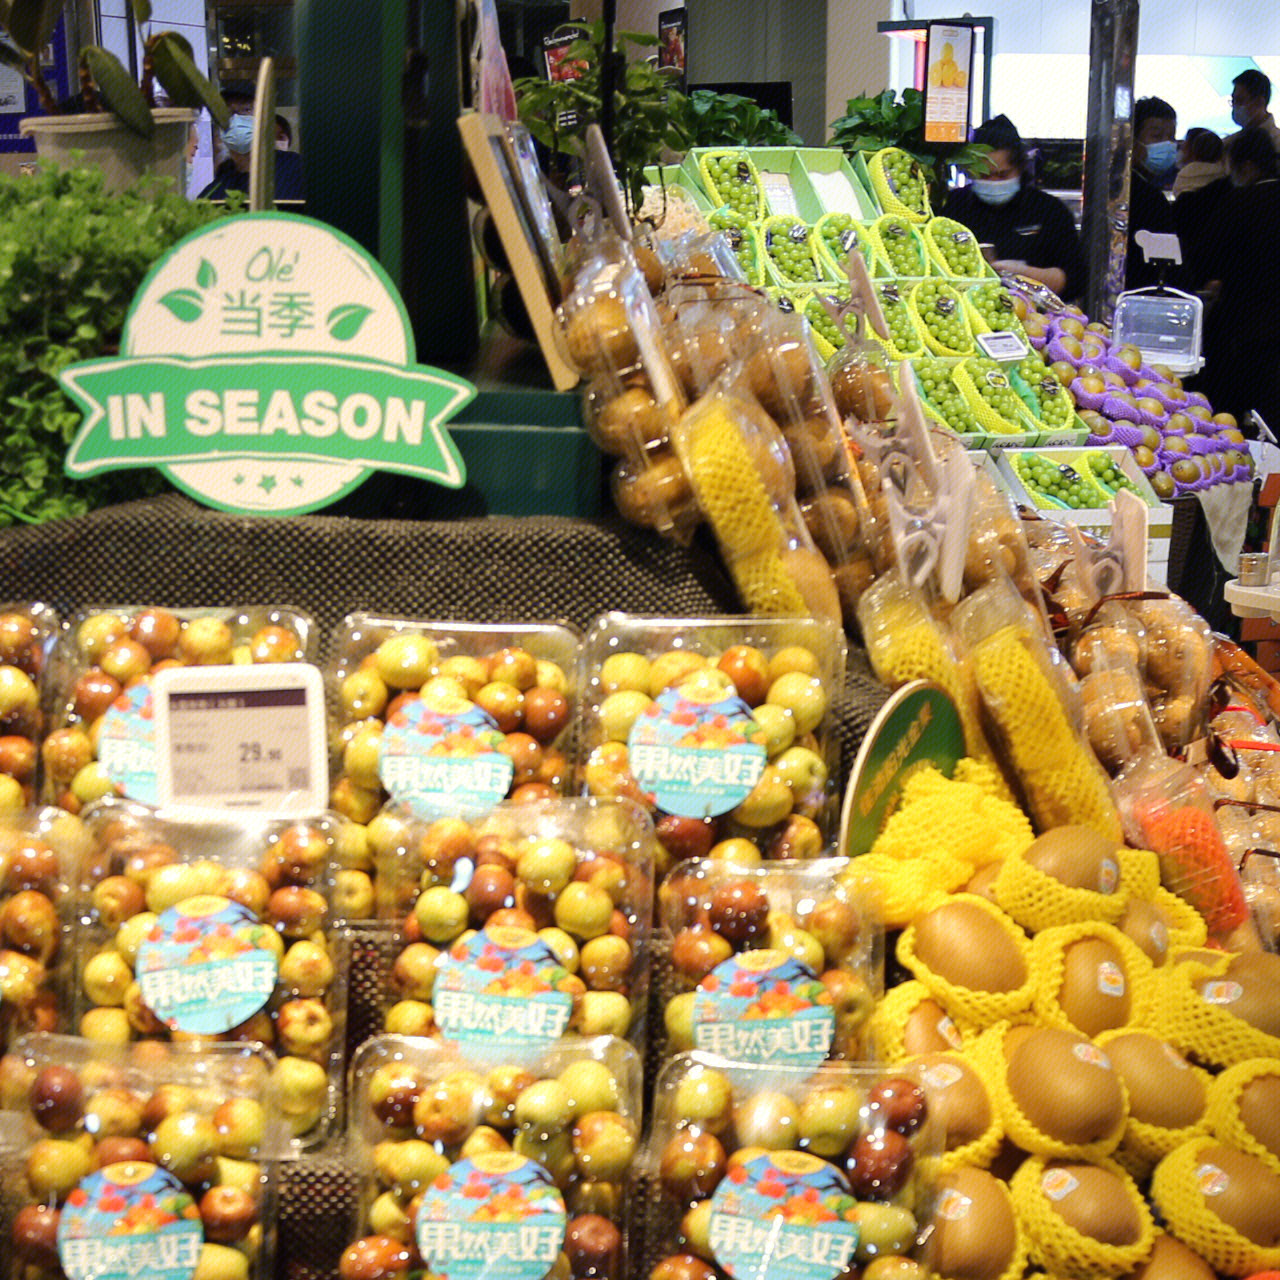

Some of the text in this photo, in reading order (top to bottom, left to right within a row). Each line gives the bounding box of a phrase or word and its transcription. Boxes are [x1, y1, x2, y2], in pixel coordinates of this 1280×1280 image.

[221, 290, 315, 338] 当季
[107, 389, 426, 446] IN SEASON
[380, 753, 514, 797] 果然美好
[630, 745, 764, 787] 果然美好
[139, 959, 277, 1008] 果然美好
[433, 990, 572, 1039] 果然美好
[695, 1016, 834, 1061] 果然美好
[61, 1230, 205, 1274] 果然美好
[419, 1221, 564, 1267] 果然美好
[710, 1218, 858, 1270] 果然美好
